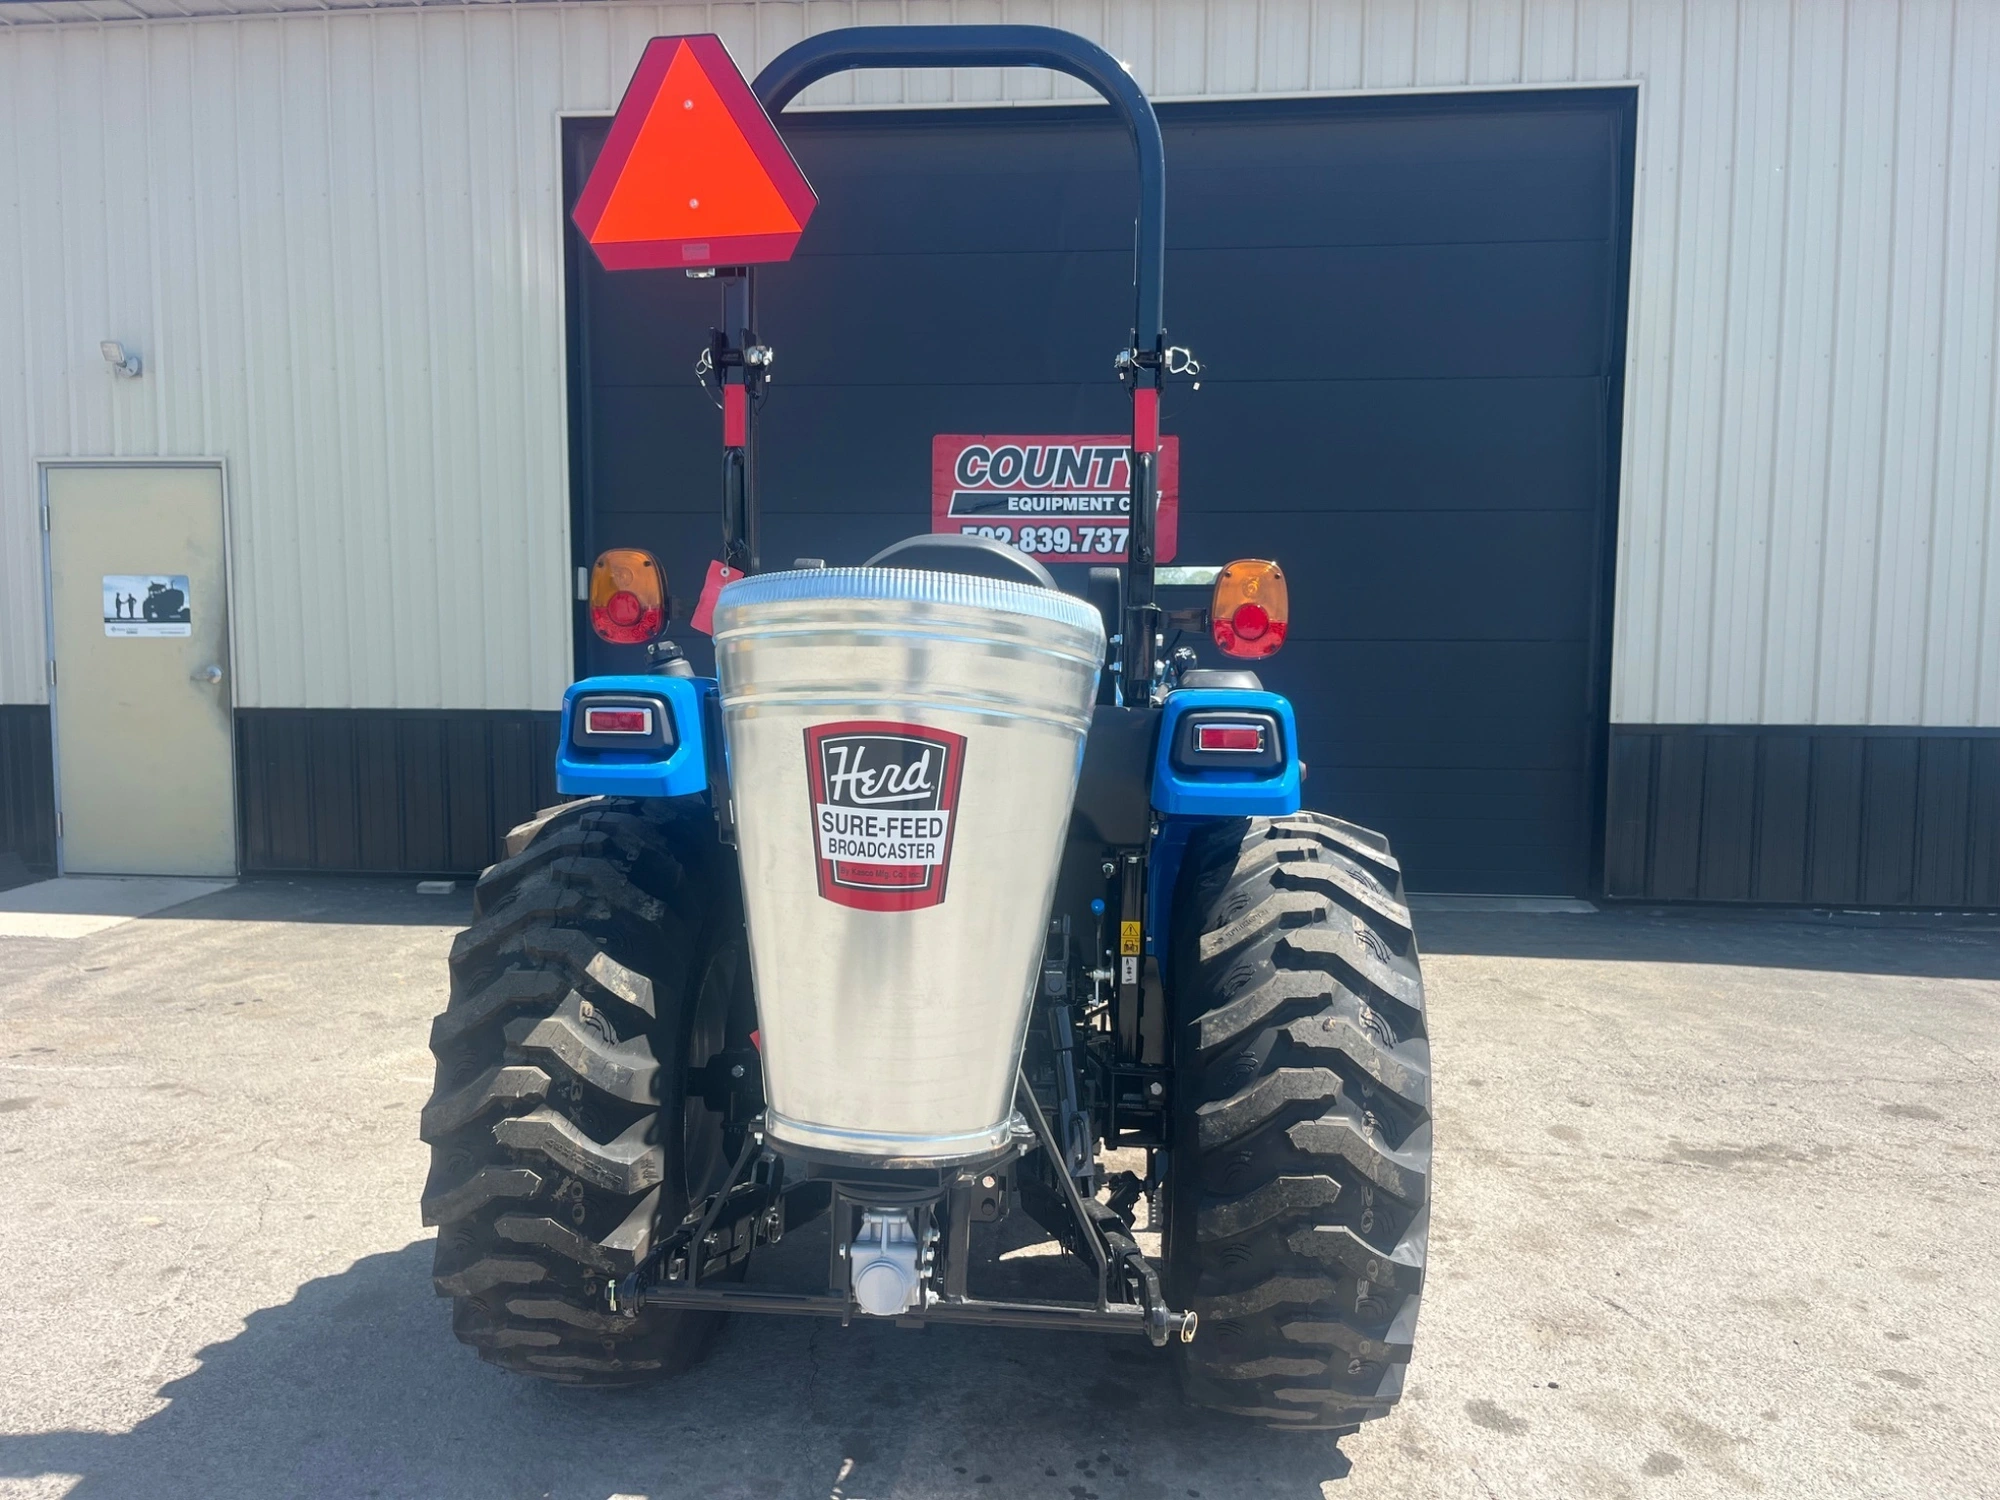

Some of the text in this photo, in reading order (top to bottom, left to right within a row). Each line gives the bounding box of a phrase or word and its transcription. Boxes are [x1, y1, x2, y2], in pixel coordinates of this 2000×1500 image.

[1008, 497, 1115, 512] EQUIPMENT
[961, 526, 1129, 553] 2.839.737
[829, 746, 932, 804] Herd
[822, 811, 943, 839] SURE-FEED
[828, 838, 935, 859] BROADCASTER
